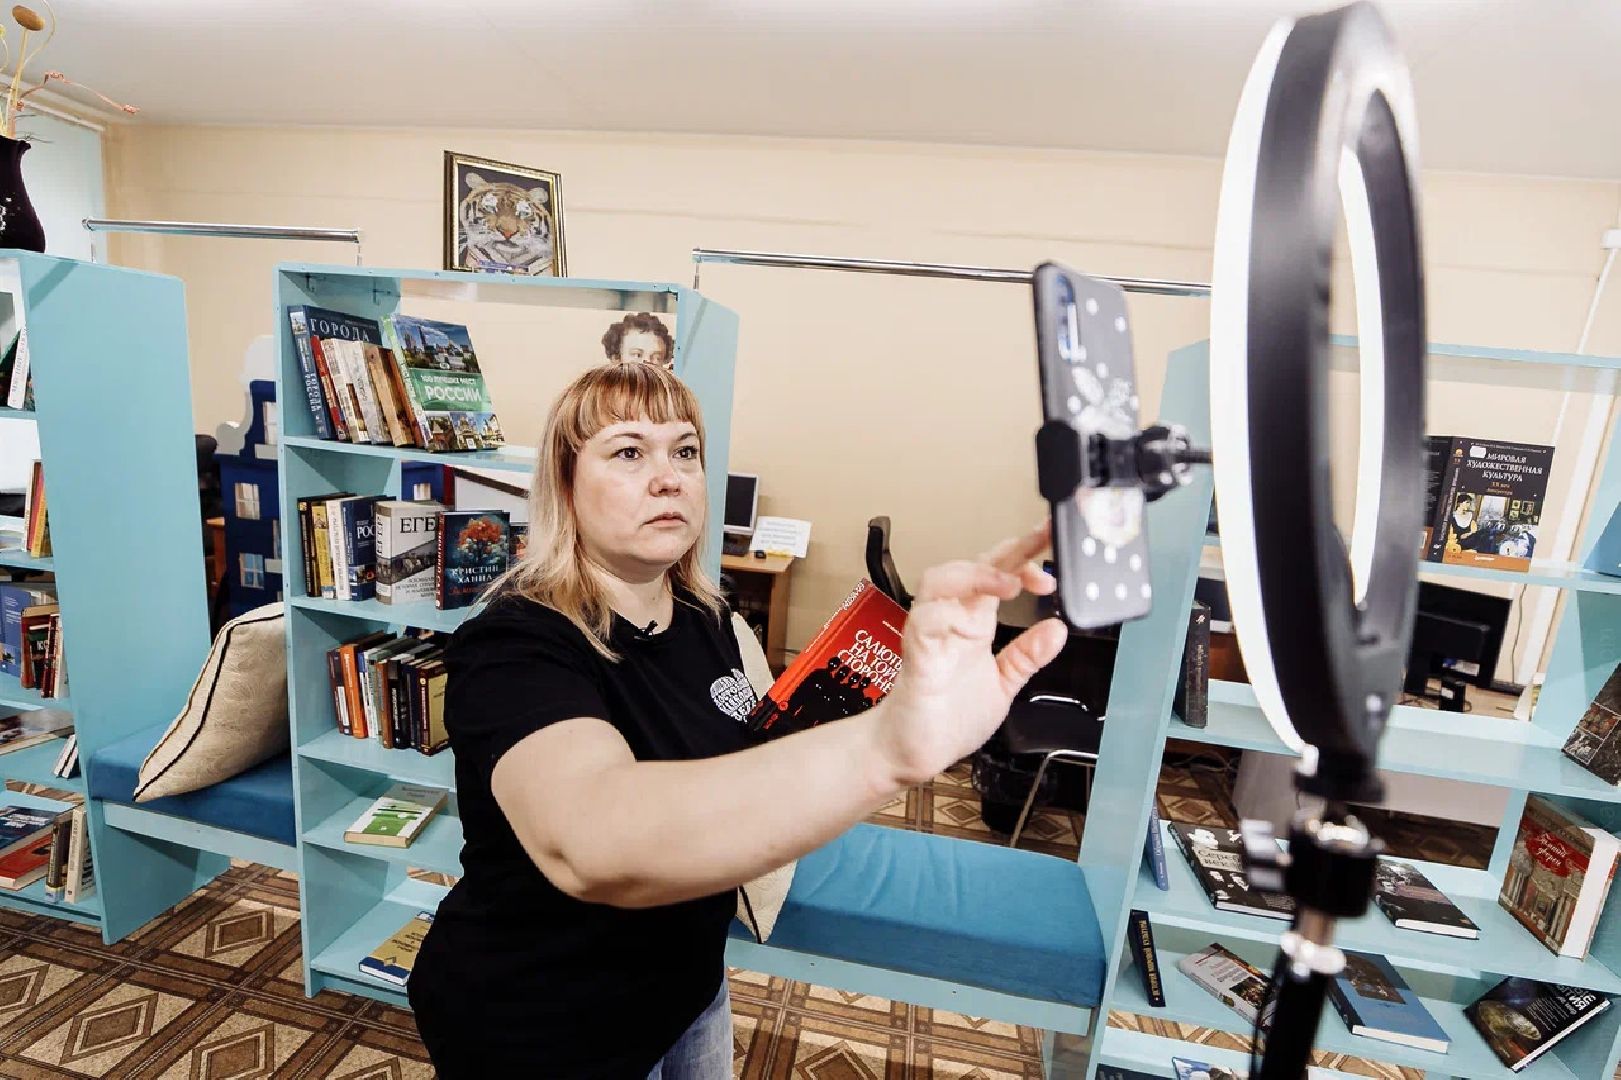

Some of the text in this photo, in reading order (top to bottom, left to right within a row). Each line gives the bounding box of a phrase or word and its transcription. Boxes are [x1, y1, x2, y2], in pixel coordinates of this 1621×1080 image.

[310, 318, 370, 342] ГОРОДА
[424, 385, 482, 402] РОССИИ
[1486, 452, 1527, 464] МИРОВАЯ
[1482, 469, 1523, 482] КУЛЬТУРА
[837, 649, 895, 694] СТОРОНЕ
[849, 642, 898, 681] НА ТОЙ
